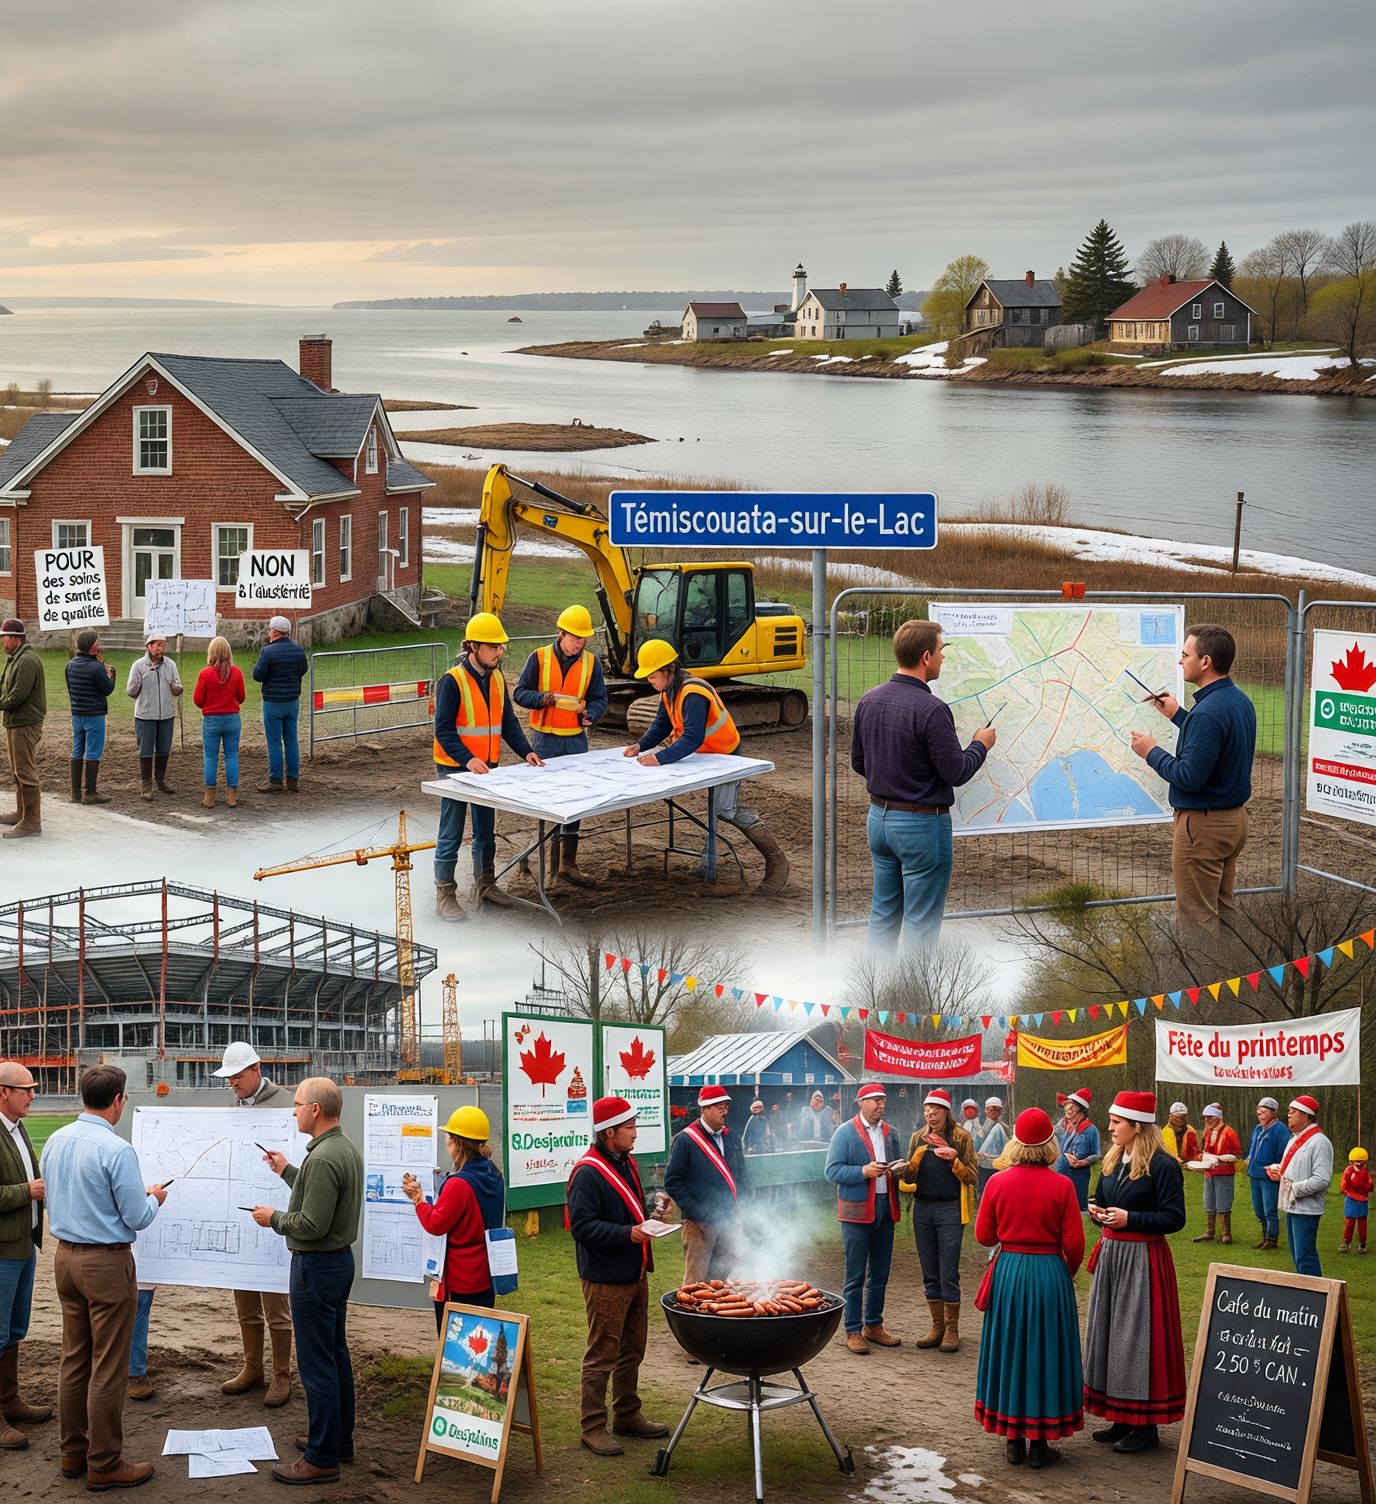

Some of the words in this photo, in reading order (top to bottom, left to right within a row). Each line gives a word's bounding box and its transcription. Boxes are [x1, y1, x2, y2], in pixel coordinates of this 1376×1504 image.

[620, 502, 925, 535] Témiscouata-sur-le-Lac
[45, 550, 95, 572] POUR
[251, 554, 294, 577] NON
[42, 576, 65, 588] des
[69, 572, 101, 586] soins
[43, 609, 58, 621] de
[1168, 1030, 1203, 1057] Fête
[1208, 1031, 1231, 1058] du
[1238, 1029, 1345, 1065] printemps
[1217, 1290, 1250, 1316] Café
[1253, 1297, 1271, 1319] du
[1276, 1304, 1319, 1328] matin
